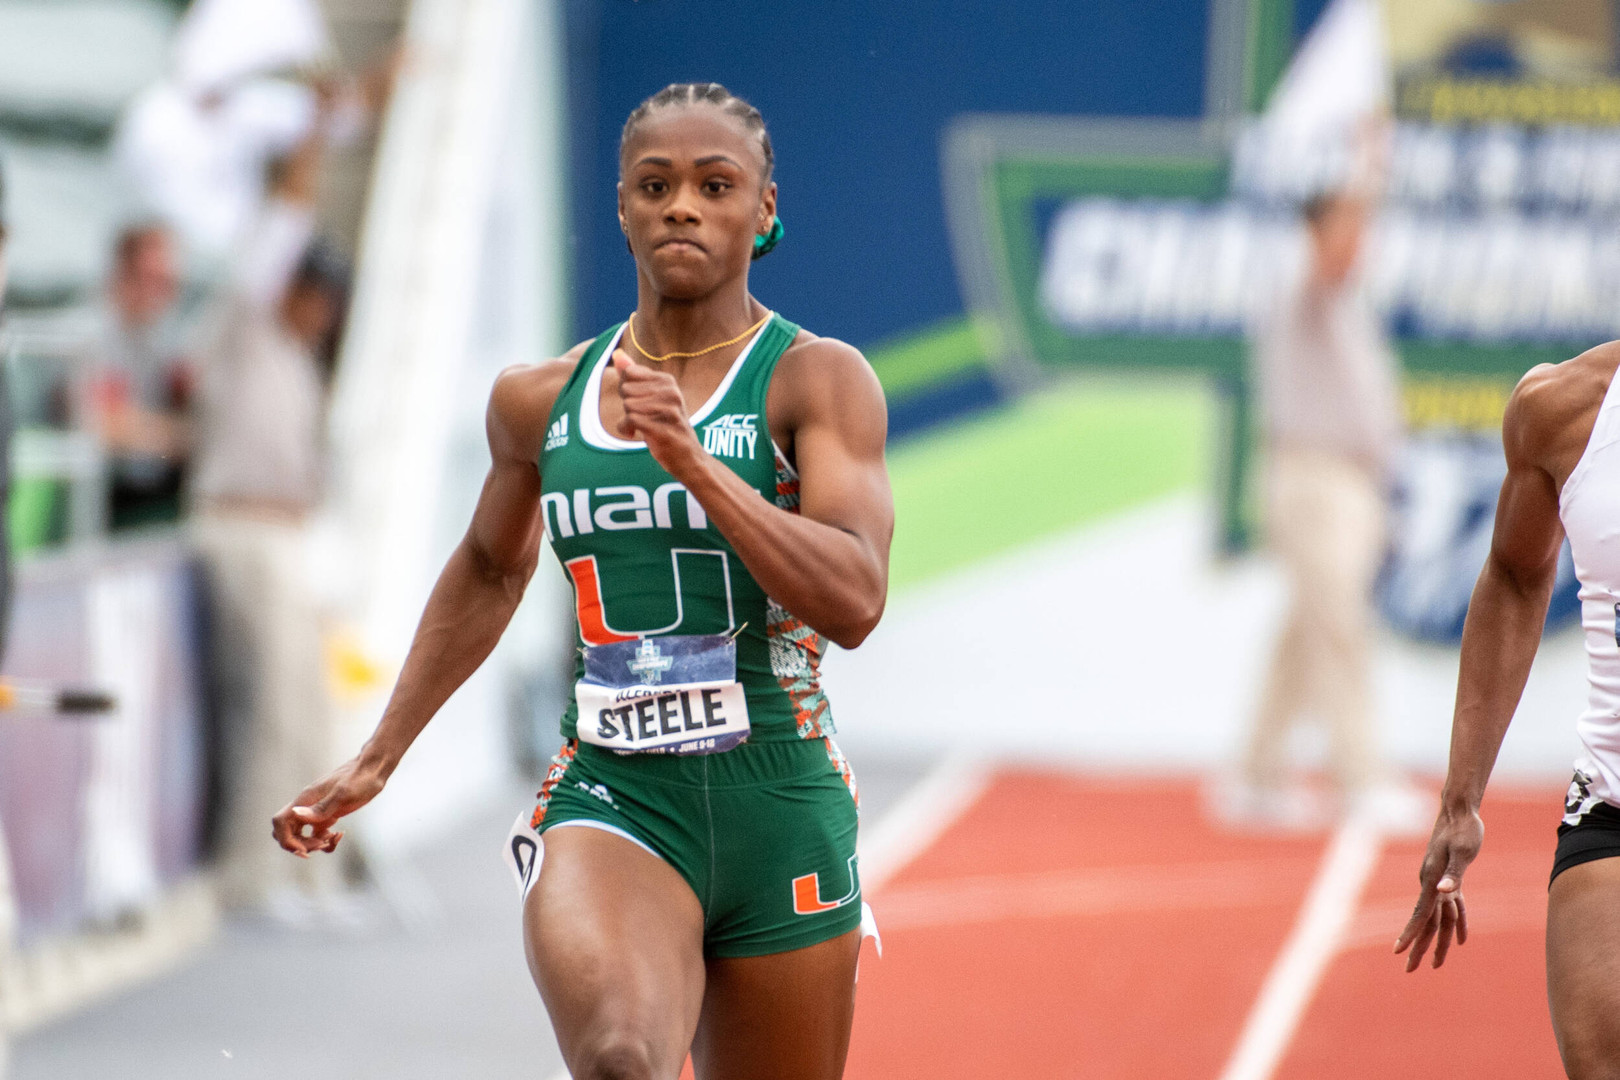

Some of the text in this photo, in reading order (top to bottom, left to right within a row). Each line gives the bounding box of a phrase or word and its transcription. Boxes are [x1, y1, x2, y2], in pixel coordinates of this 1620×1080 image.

[708, 414, 759, 429] ACC
[703, 427, 758, 460] UNITY
[564, 548, 735, 647] U
[598, 689, 727, 742] STEELE
[679, 741, 698, 753] JUNE
